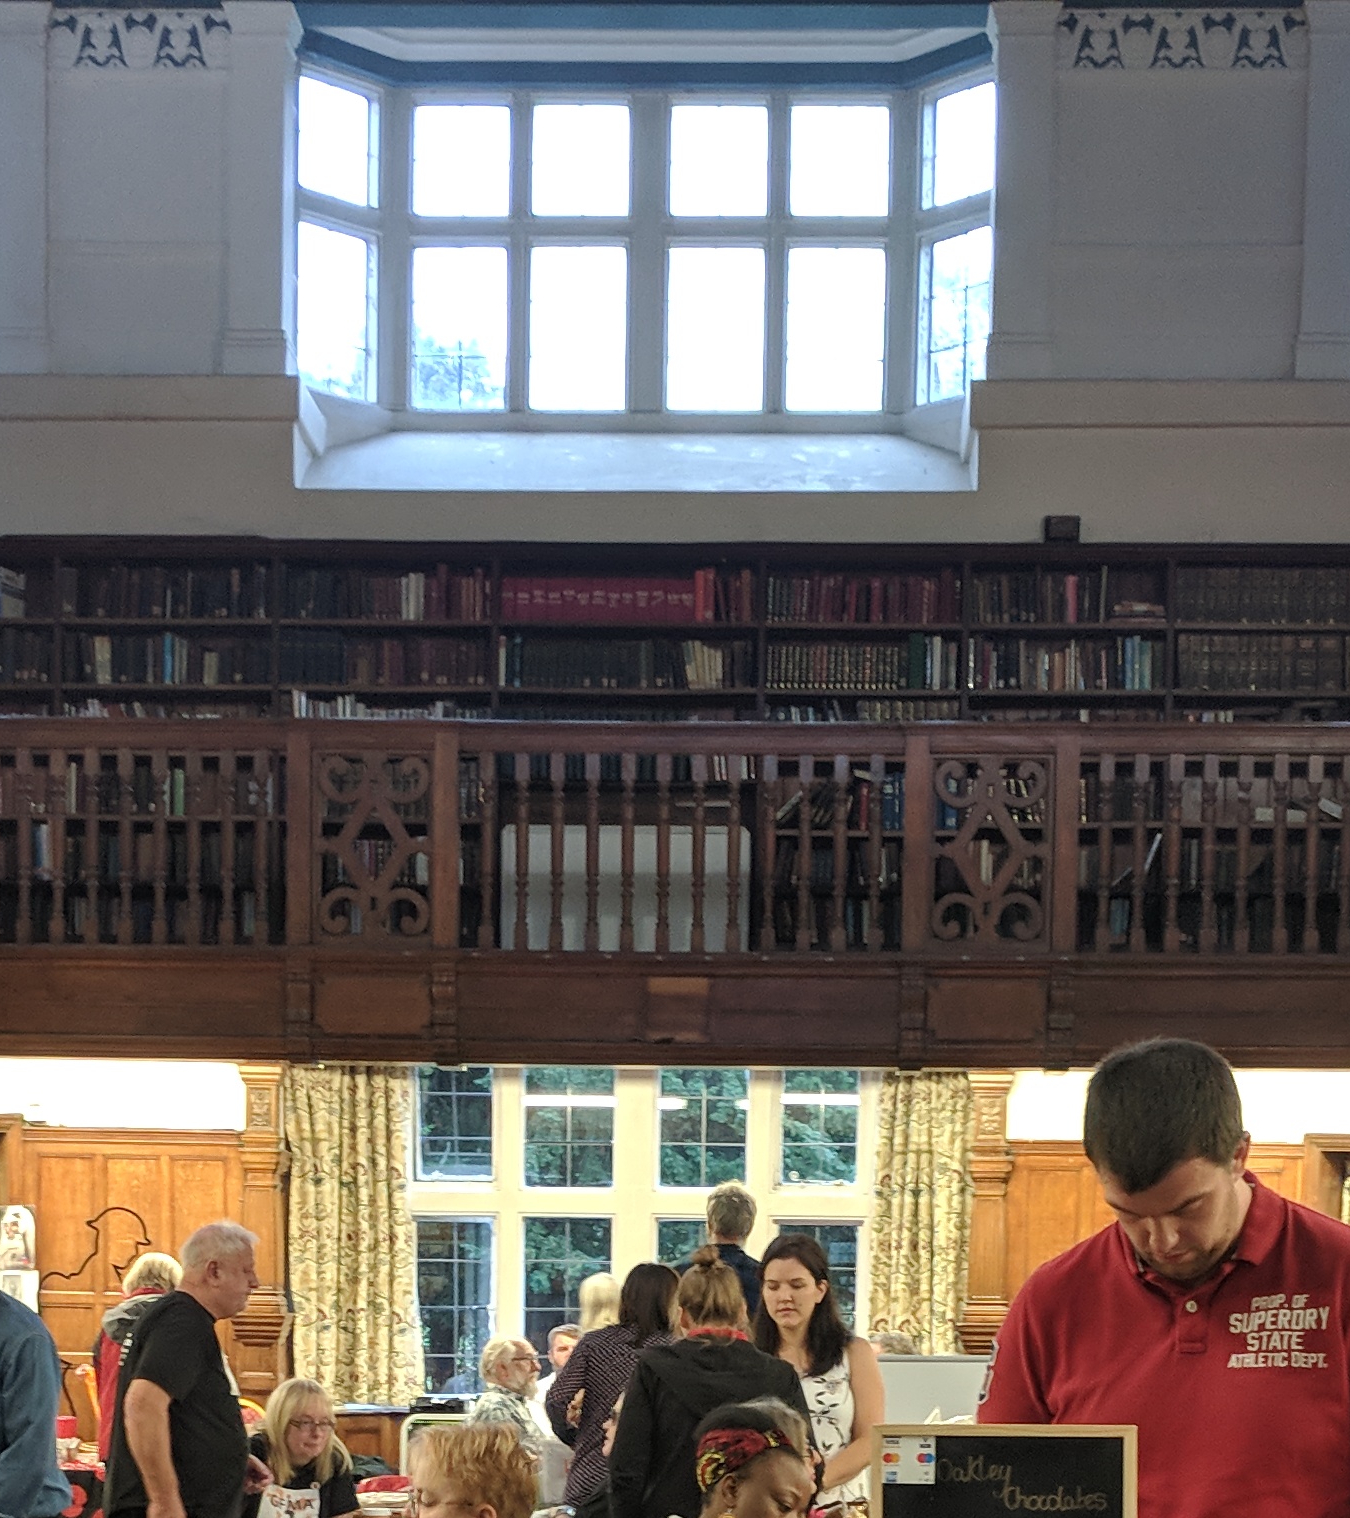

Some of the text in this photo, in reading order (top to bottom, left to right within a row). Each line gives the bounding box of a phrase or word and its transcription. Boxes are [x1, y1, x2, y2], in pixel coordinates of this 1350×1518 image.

[1291, 1294, 1310, 1309] OF
[1228, 1306, 1330, 1334] SUPERDRY
[1246, 1331, 1306, 1351] STATE
[1227, 1352, 1290, 1369] ATHLETIC
